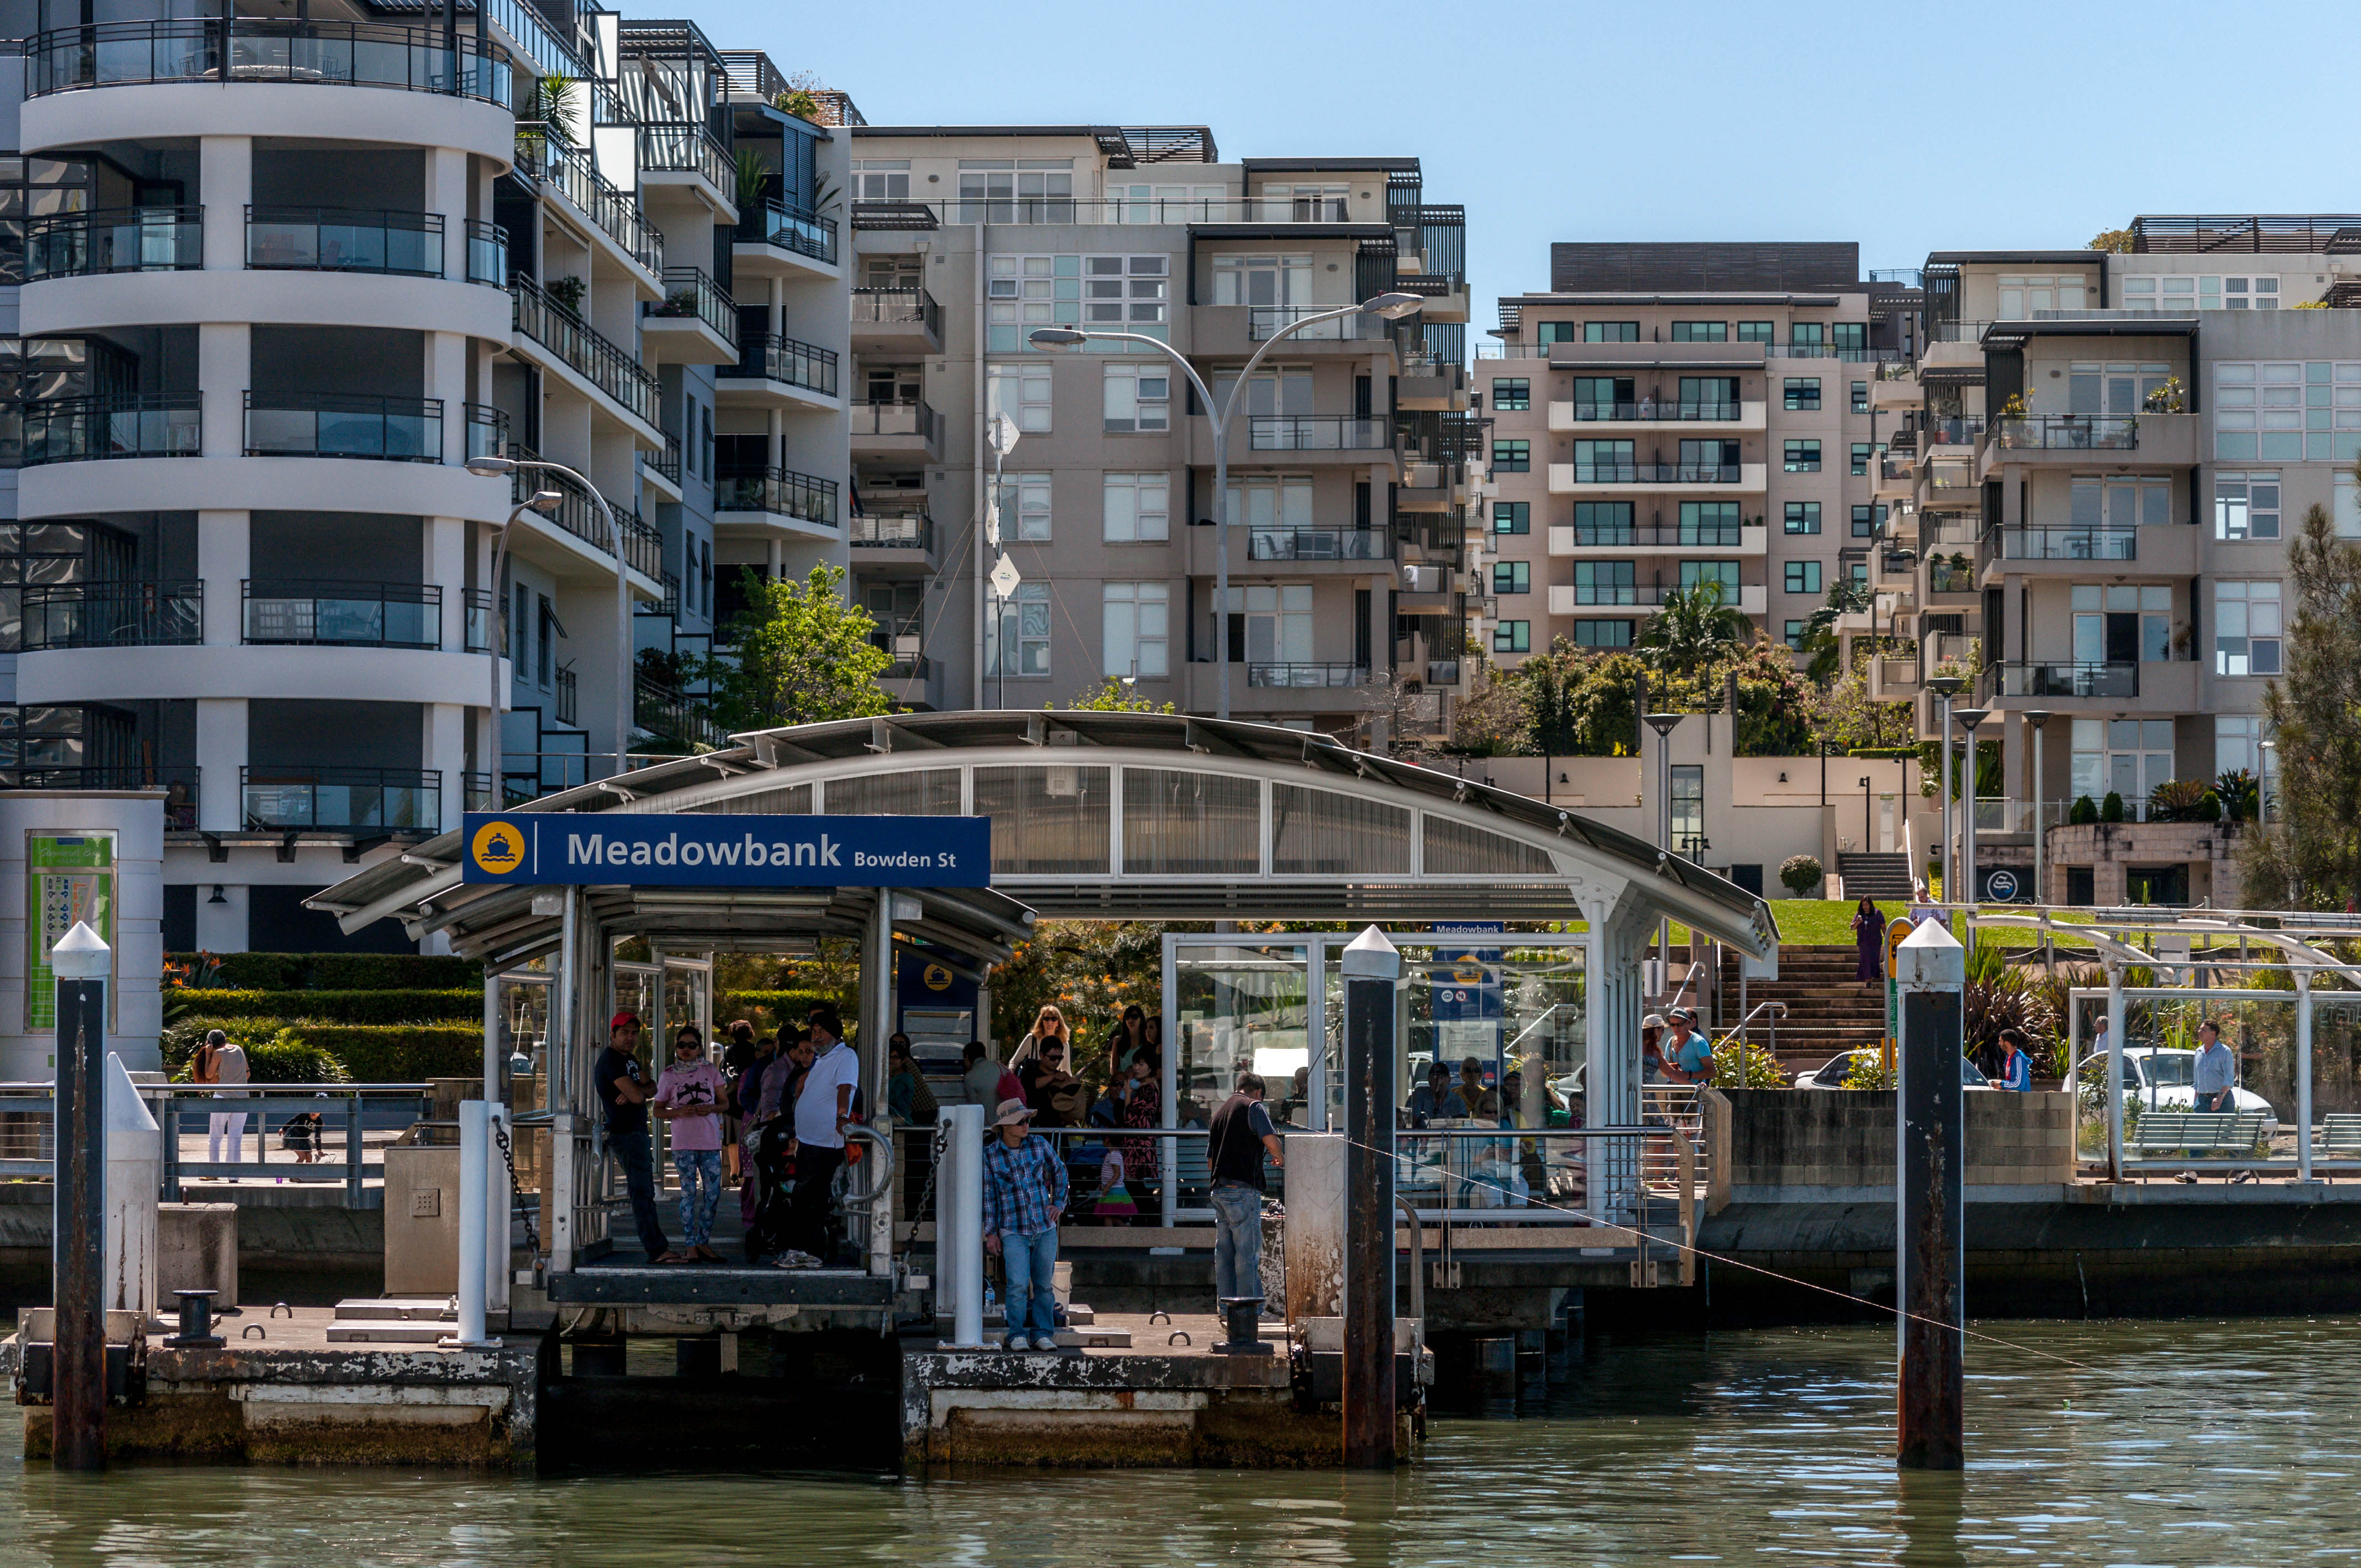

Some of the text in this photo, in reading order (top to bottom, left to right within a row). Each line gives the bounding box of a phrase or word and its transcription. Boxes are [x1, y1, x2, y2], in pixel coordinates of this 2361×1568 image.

[568, 832, 956, 868] Meadowbank Bowden St
[1437, 925, 1499, 933] Meadowbank
